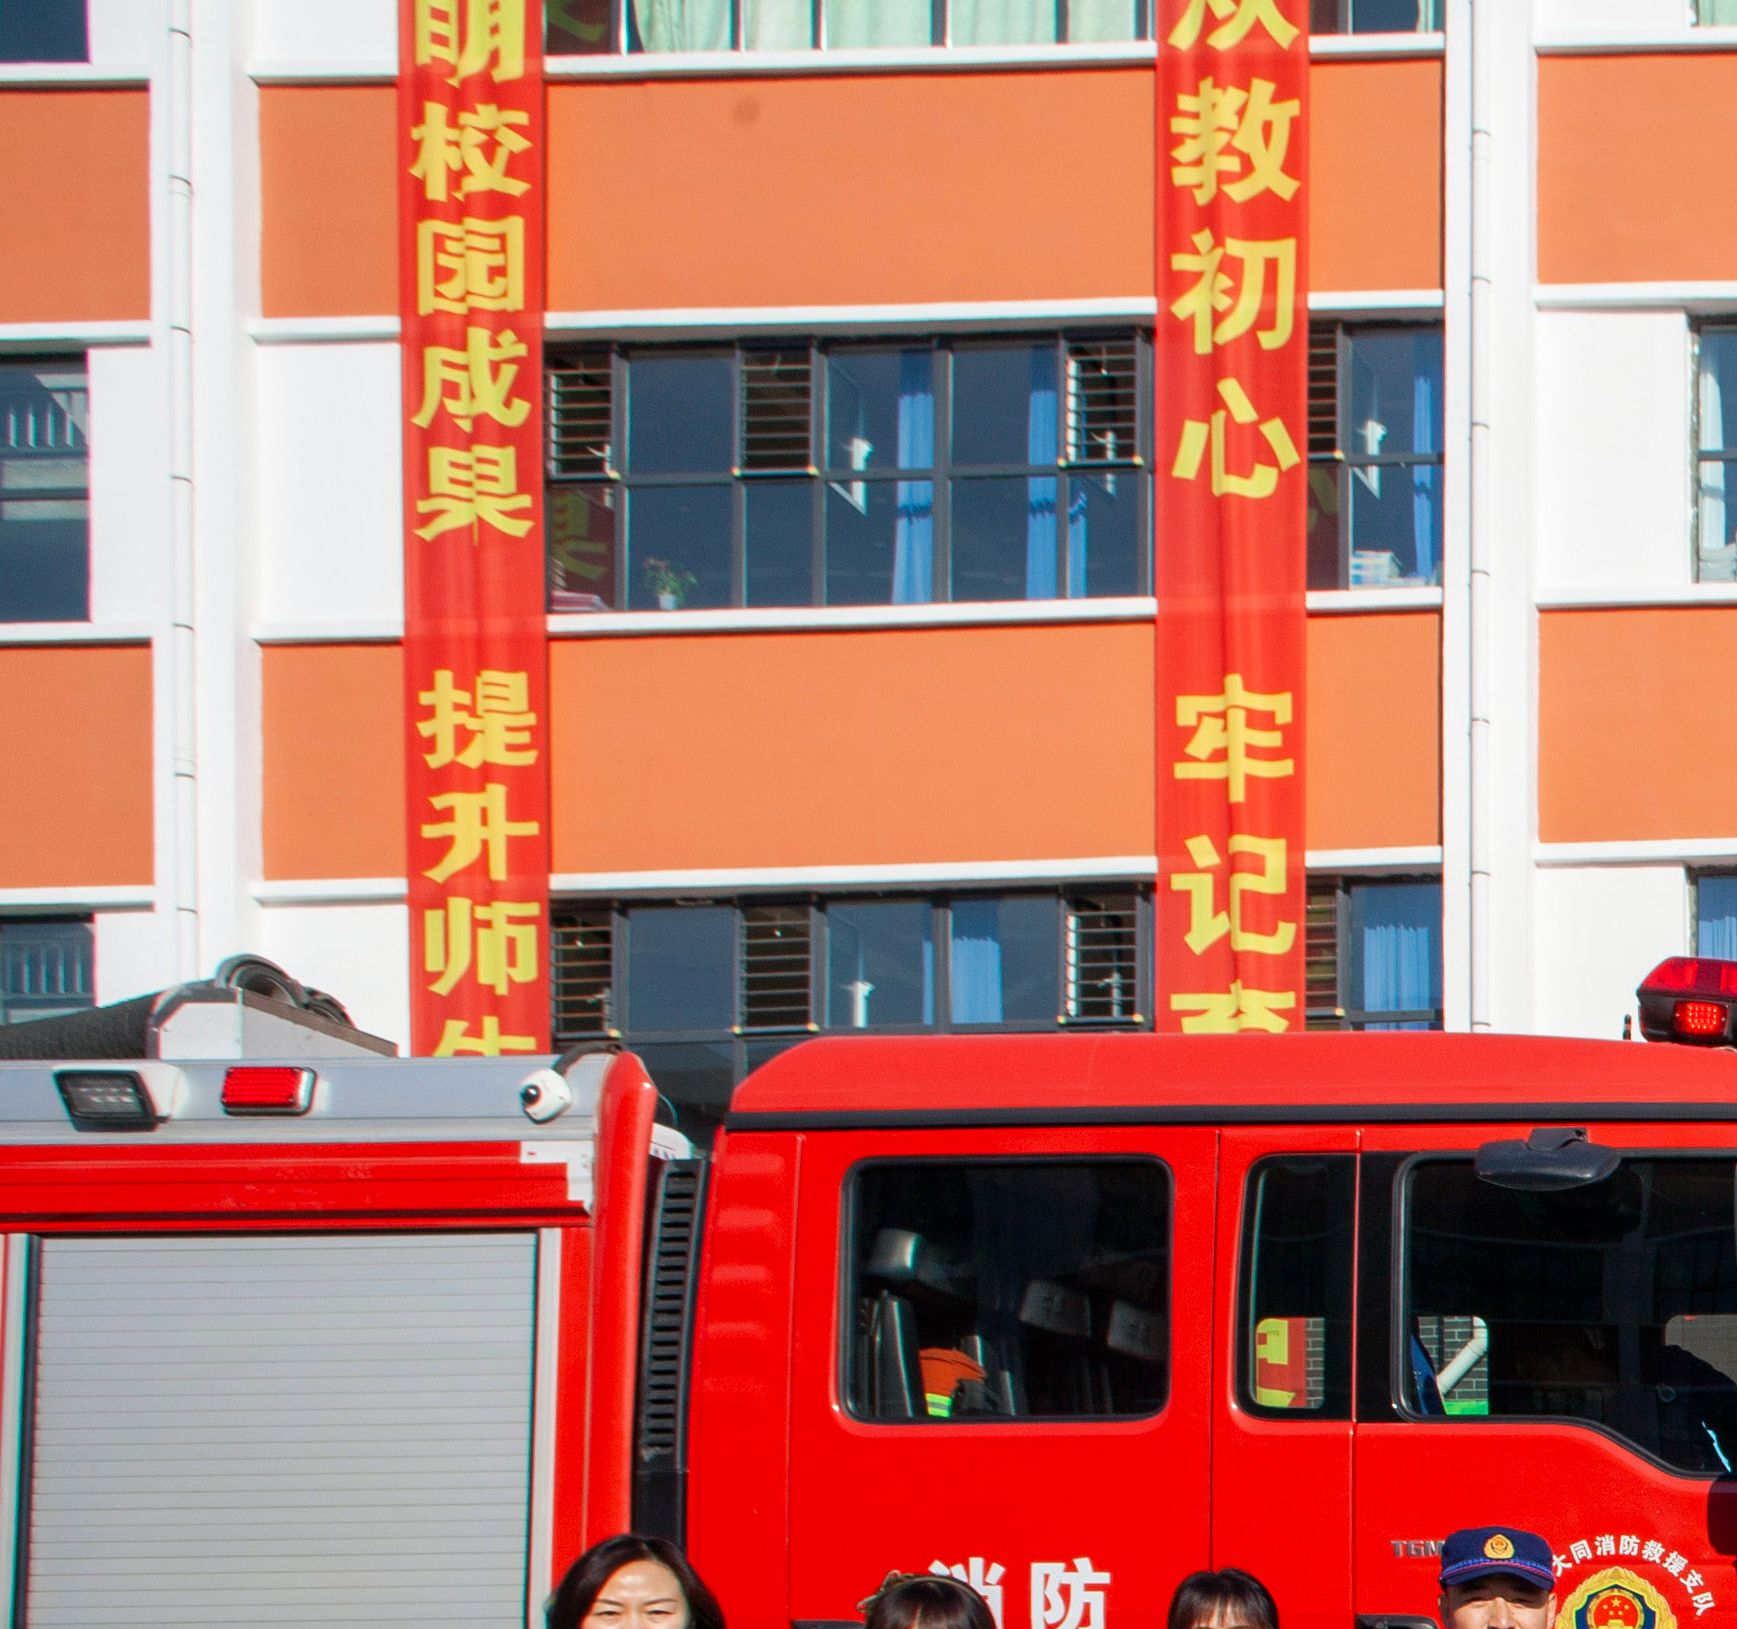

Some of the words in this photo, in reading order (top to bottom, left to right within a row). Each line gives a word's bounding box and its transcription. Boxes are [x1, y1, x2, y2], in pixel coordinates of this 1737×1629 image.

[1552, 1534, 1716, 1617] 大同消防救援支队
